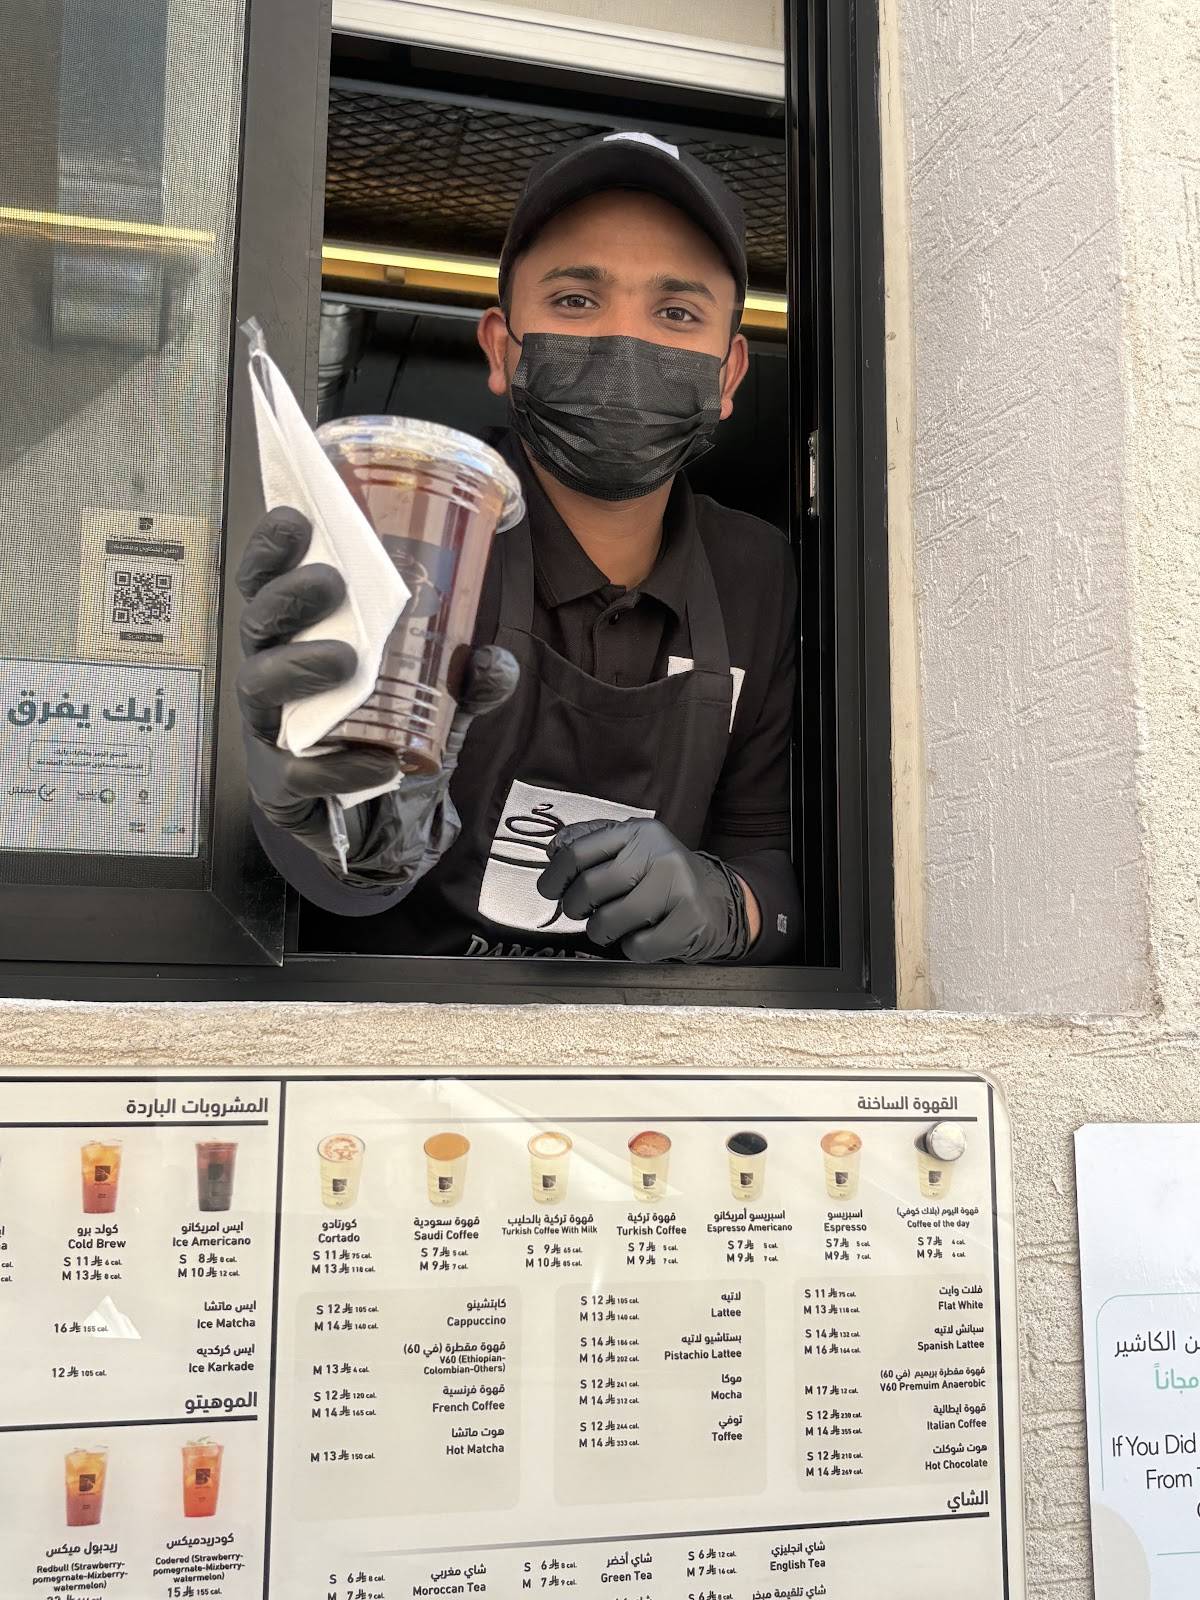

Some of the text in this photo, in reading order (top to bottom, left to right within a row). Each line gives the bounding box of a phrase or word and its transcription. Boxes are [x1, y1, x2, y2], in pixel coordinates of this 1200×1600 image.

[8, 688, 176, 731] رأيك يفرق
[127, 1096, 268, 1118] المشروبات الباردة
[858, 1096, 957, 1114] القهوة الساخنة
[714, 1208, 785, 1222] اسبريسو أمريكانو
[828, 1209, 863, 1220] اسبريسو
[942, 1207, 958, 1216] اليوم
[960, 1207, 979, 1216] قهوة
[414, 1216, 480, 1229] قهوة سعودية
[508, 1214, 593, 1226] قهوة تركية بالحليب
[628, 1212, 676, 1224] قهوة تركية
[907, 1220, 931, 1228] Coffee
[956, 1220, 970, 1228] day
[77, 1224, 118, 1237] كولد برو
[181, 1221, 243, 1235] ايس امريكانو
[322, 1219, 357, 1231] كورتادو
[502, 1227, 531, 1235] Turkish
[534, 1226, 559, 1235] Coffee
[561, 1226, 579, 1234] With
[616, 1225, 686, 1235] Turkish Coffee
[707, 1223, 792, 1234] Espresso Americano
[824, 1223, 867, 1233] Espresso
[318, 1233, 360, 1243] Cortado
[414, 1230, 479, 1240] Saudi Coffee
[68, 1239, 126, 1249] Cold Brew
[173, 1236, 251, 1247] Ice Americano
[939, 1285, 983, 1296] فلات وايت
[721, 1291, 741, 1303] لاتيه
[204, 1300, 256, 1313] ايس ماتشا
[467, 1298, 506, 1311] كابتشينو
[939, 1300, 983, 1310] Flat White
[711, 1308, 741, 1317] Lattee
[197, 1317, 255, 1328] Ice Matcha
[447, 1315, 506, 1328] Cappuccino
[934, 1324, 984, 1336] سبانش لاتيه
[681, 1332, 741, 1345] بستاشيو لاتيه
[1114, 1330, 1175, 1357] الكاشير
[197, 1344, 255, 1357] ايس كركديه
[445, 1342, 477, 1354] مقطرة
[480, 1341, 505, 1353] قهوة
[918, 1340, 984, 1352] Spanish Lattee
[440, 1355, 505, 1364] V60 (Ethiopian-
[664, 1349, 742, 1360] Pistachio Lattee
[189, 1361, 254, 1373] Ice Karkade
[424, 1363, 505, 1375] Colombian-Others)
[939, 1368, 964, 1377] مقطرة
[966, 1366, 985, 1376] قهوة
[722, 1374, 742, 1385] موكا
[914, 1371, 937, 1379] بريميم
[443, 1384, 505, 1397] قهوة فرنسية
[880, 1379, 986, 1392] V60 Premuim Anaerobic
[711, 1390, 742, 1400] Mocha
[185, 1391, 257, 1414] الموهيتو
[433, 1401, 505, 1412] French Coffee
[933, 1403, 986, 1416] قهوة ايطالية
[719, 1415, 743, 1429] توفي
[927, 1419, 987, 1430] Italian Coffee
[452, 1427, 504, 1438] هوت ماتشا
[712, 1432, 742, 1441] Toffee
[446, 1443, 504, 1455] Hot Matcha
[933, 1443, 987, 1455] هوت شوكلت
[1112, 1433, 1196, 1457] If You Did
[925, 1459, 988, 1470] Hot Chocolate
[1146, 1469, 1192, 1489] From
[947, 1490, 988, 1512] الشاي
[46, 1542, 117, 1558] ريدبول ميكس
[771, 1540, 825, 1557] شاي انجليزي
[156, 1553, 243, 1565] Codered (Strawberry-
[606, 1551, 652, 1568] شاي أخضر
[770, 1558, 825, 1572] English Tea
[37, 1561, 125, 1573] Redbull (Strawberry-
[431, 1563, 486, 1582] شاي مغربي
[173, 1571, 224, 1583] watermelon)
[601, 1571, 652, 1583] Green Tea
[54, 1580, 107, 1592] watermelon)
[413, 1582, 486, 1596] Moroccan Tea
